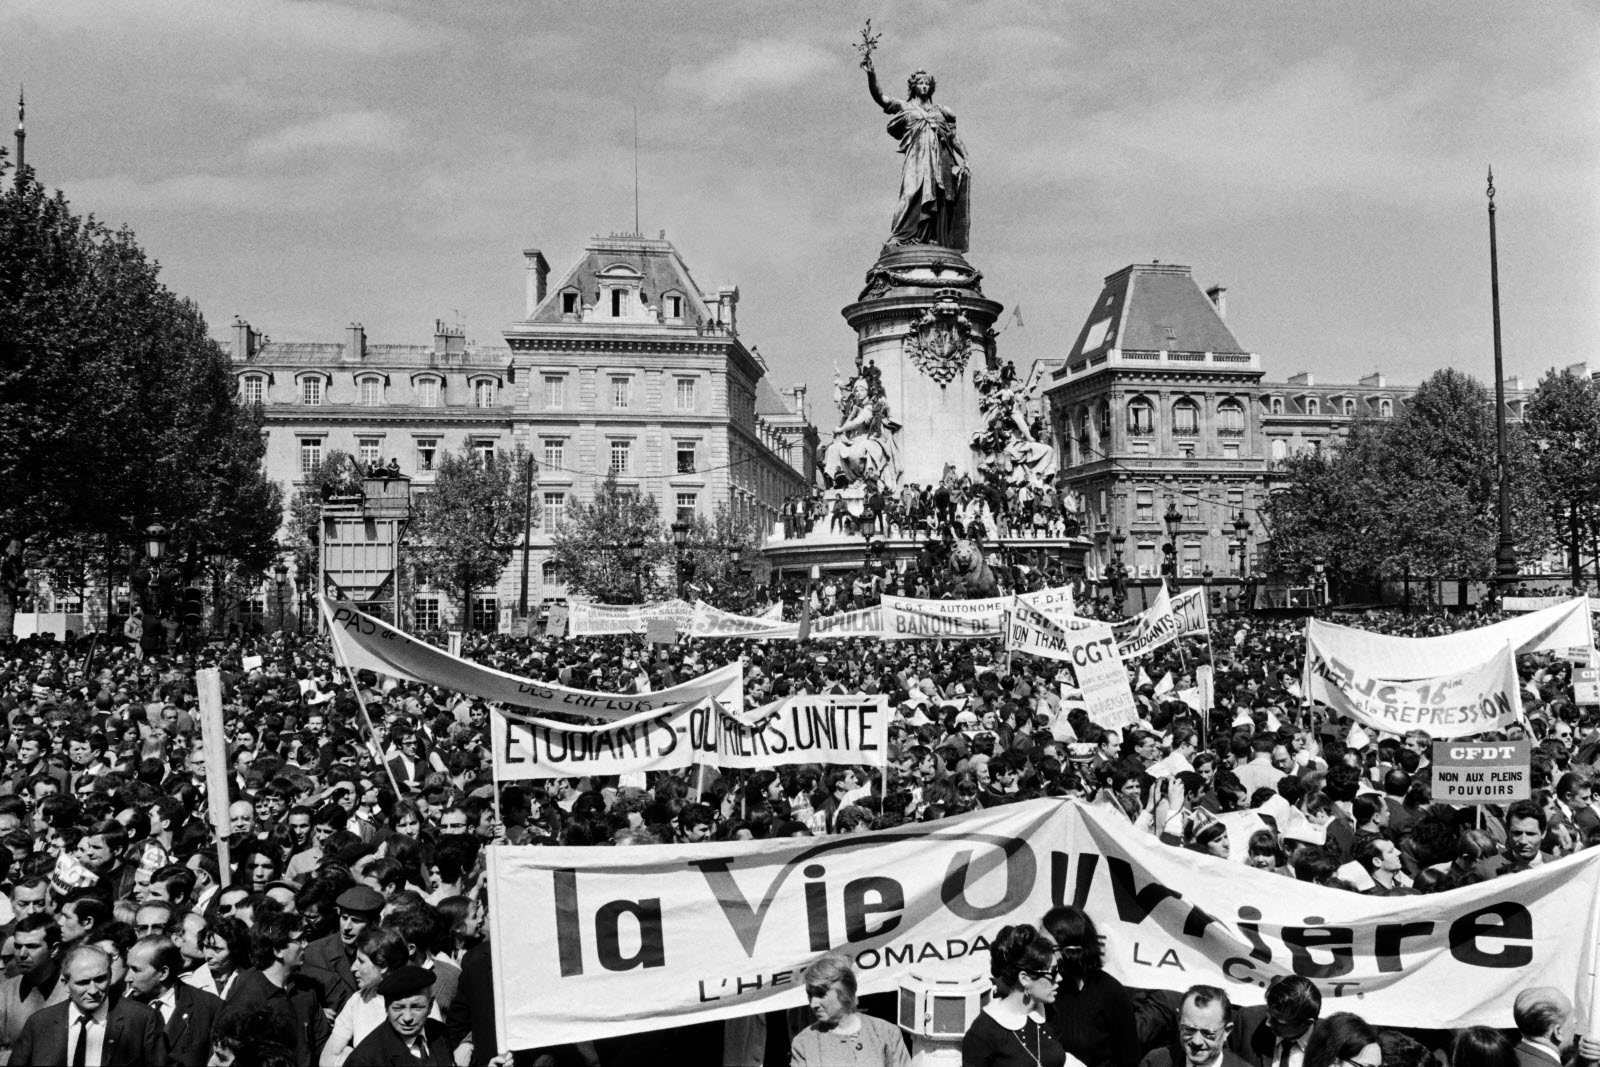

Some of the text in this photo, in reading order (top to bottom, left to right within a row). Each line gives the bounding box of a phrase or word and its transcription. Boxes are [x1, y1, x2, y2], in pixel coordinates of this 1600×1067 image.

[1125, 564, 1193, 579] REUIS
[940, 602, 1002, 612] AUTONOME
[332, 608, 397, 640] PAS de
[896, 614, 967, 635] BANQUE
[971, 618, 990, 633] DE
[1118, 613, 1175, 656] ETUDIANTS
[1072, 637, 1113, 667] CGT
[563, 693, 652, 713] EMPLOIS
[1450, 746, 1515, 760] CFDT
[1439, 771, 1523, 782] NON AUX PLEINS
[1449, 785, 1514, 795] POUVOIRS
[553, 867, 666, 977] la
[688, 836, 905, 959] Vie
[1133, 942, 1186, 971] LA
